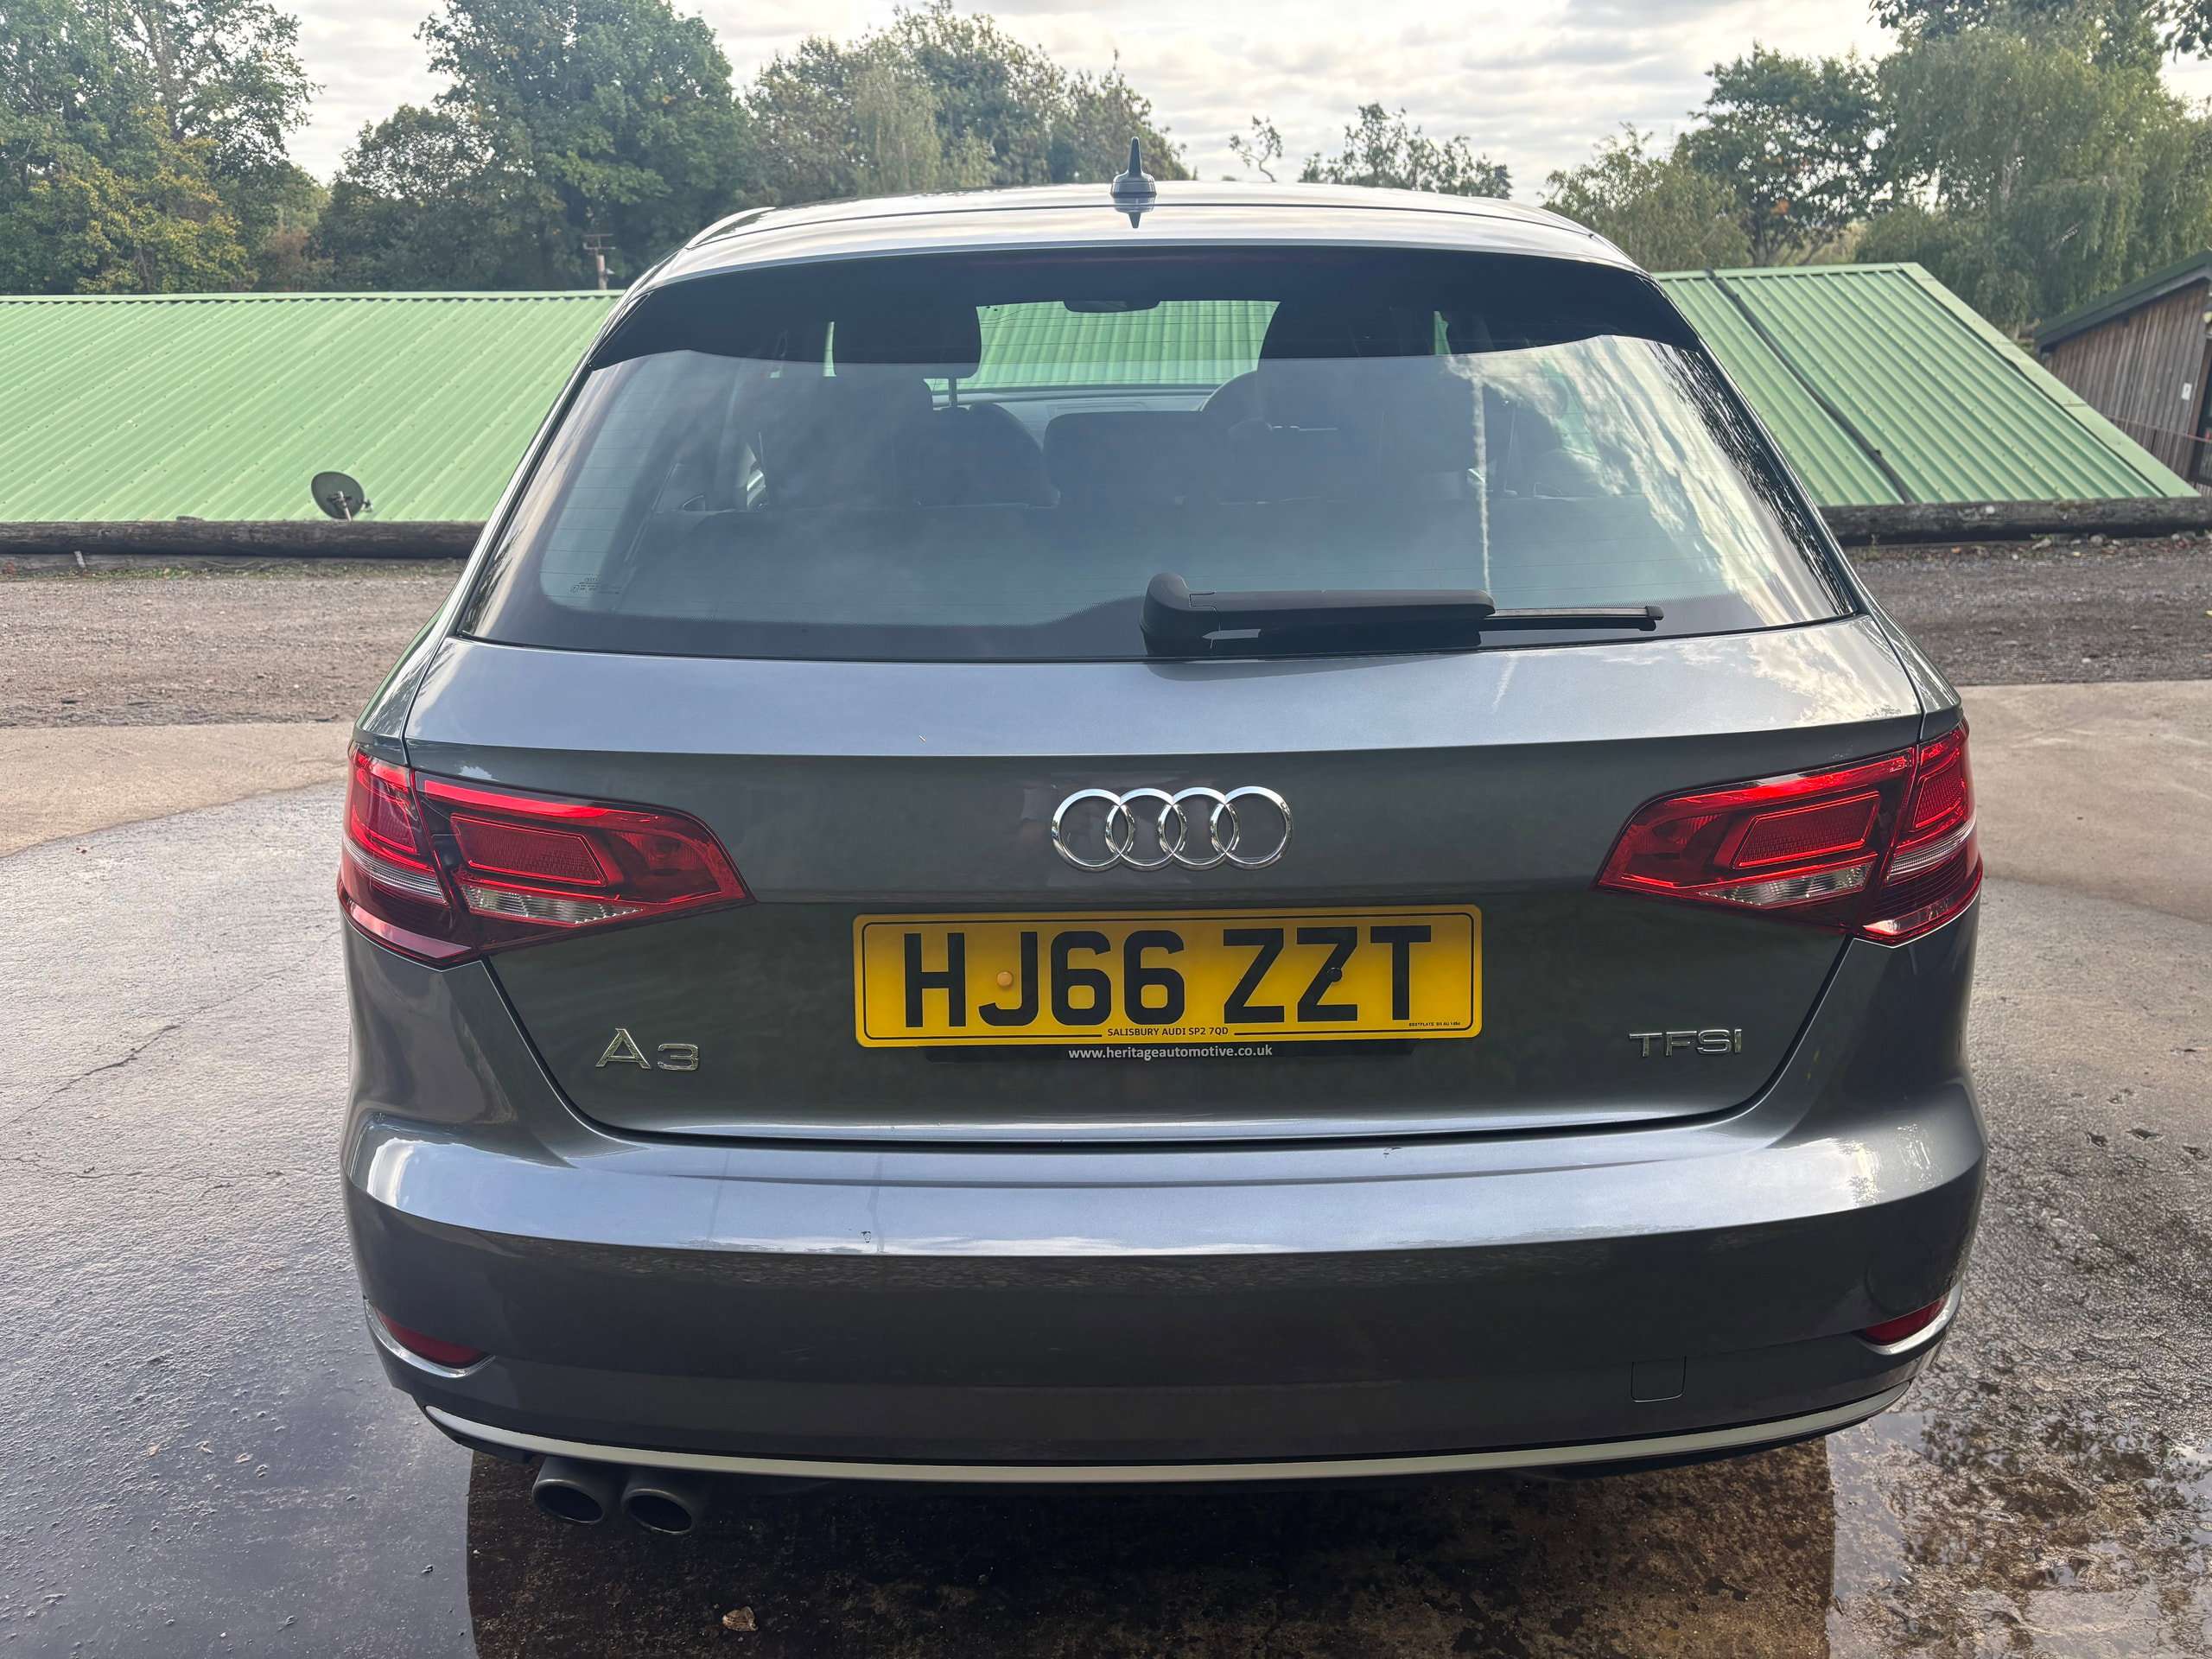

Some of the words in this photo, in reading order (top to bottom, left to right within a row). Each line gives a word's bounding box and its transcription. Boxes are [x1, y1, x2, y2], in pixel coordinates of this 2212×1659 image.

[904, 930, 1185, 1028] HJ66
[1223, 925, 1432, 1024] ZZT
[1107, 1027, 1160, 1037] SALISBURY
[1161, 1027, 1186, 1036] AUDI
[1188, 1027, 1206, 1036] SP2
[1209, 1027, 1229, 1036] 7QD
[1629, 1028, 1743, 1058] TFSI
[594, 1027, 699, 1071] A3
[1068, 1044, 1273, 1061] www.heritageautomotive.co.uk
